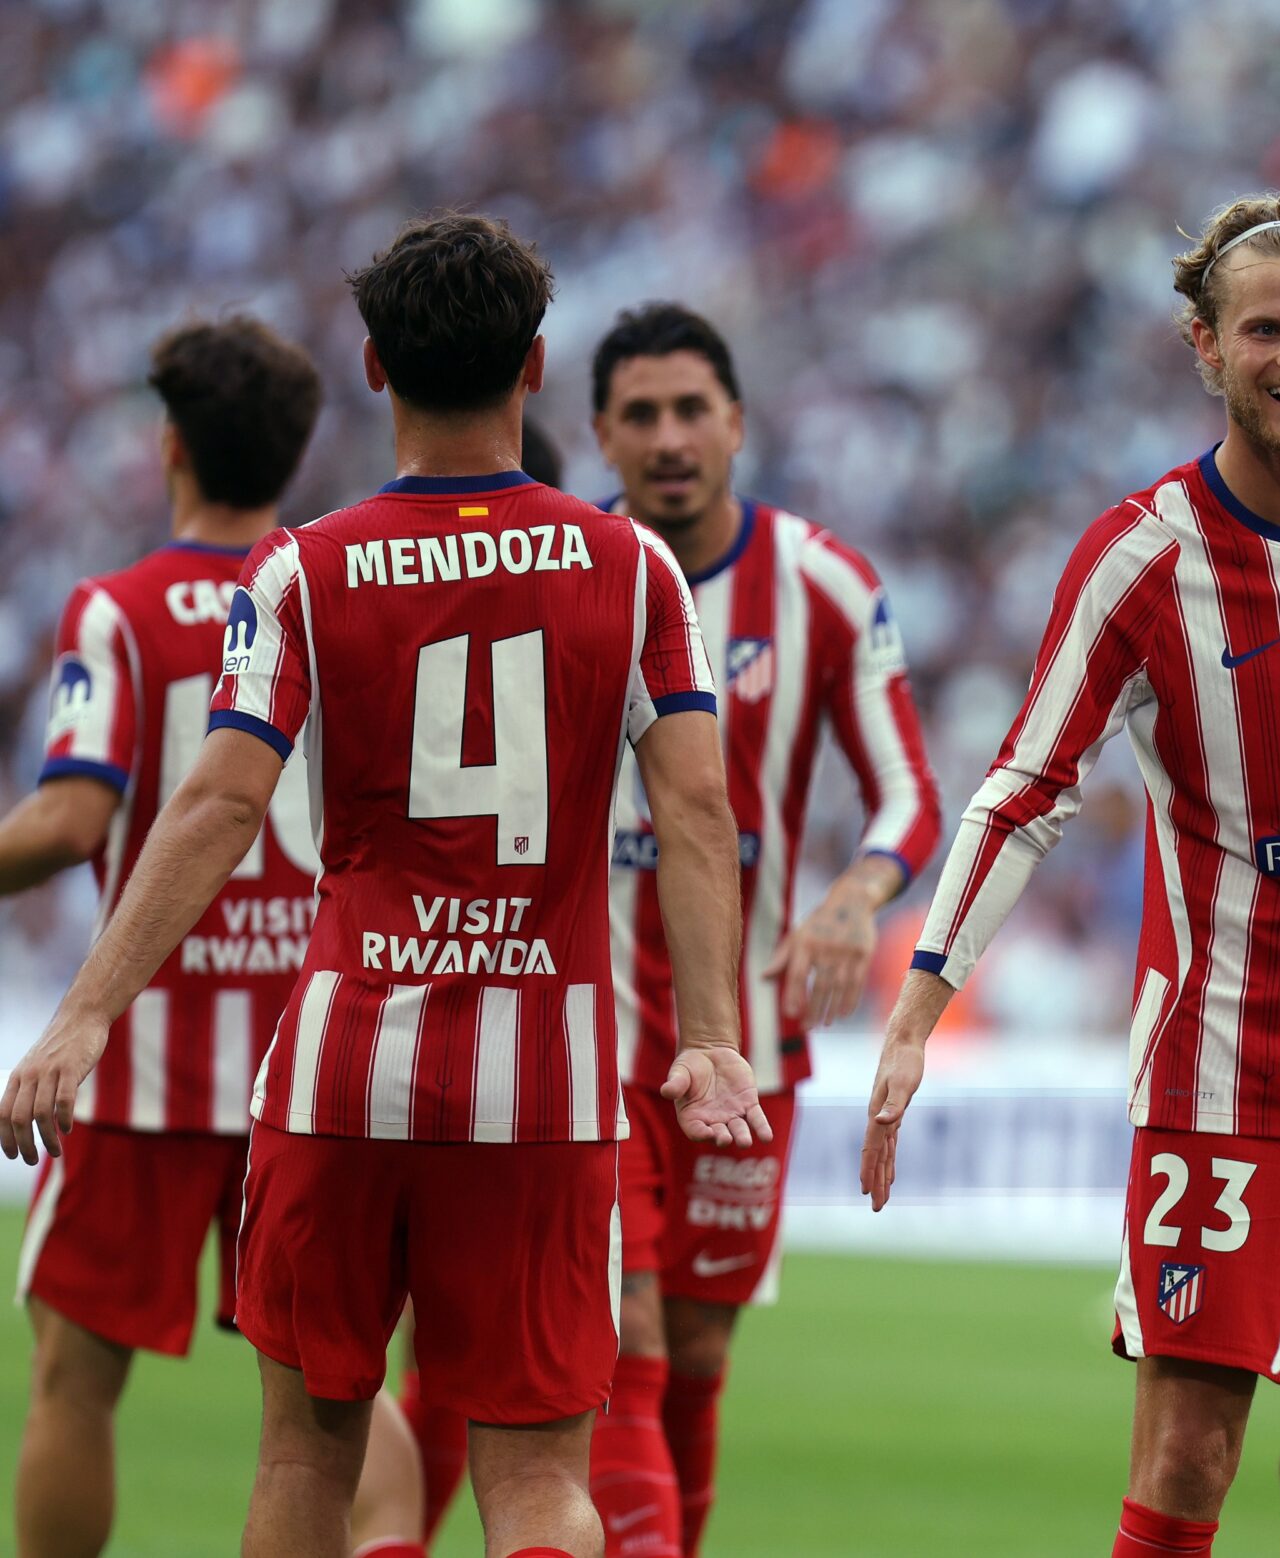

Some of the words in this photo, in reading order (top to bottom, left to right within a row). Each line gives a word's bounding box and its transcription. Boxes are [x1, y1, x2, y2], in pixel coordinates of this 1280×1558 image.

[344, 523, 594, 589] MENDOZA
[165, 579, 237, 626] CAS
[407, 628, 549, 867] 4
[412, 894, 533, 935] VISIT
[180, 935, 309, 975] RWAN
[362, 931, 558, 976] RWANDA
[1143, 1152, 1259, 1253] 23
